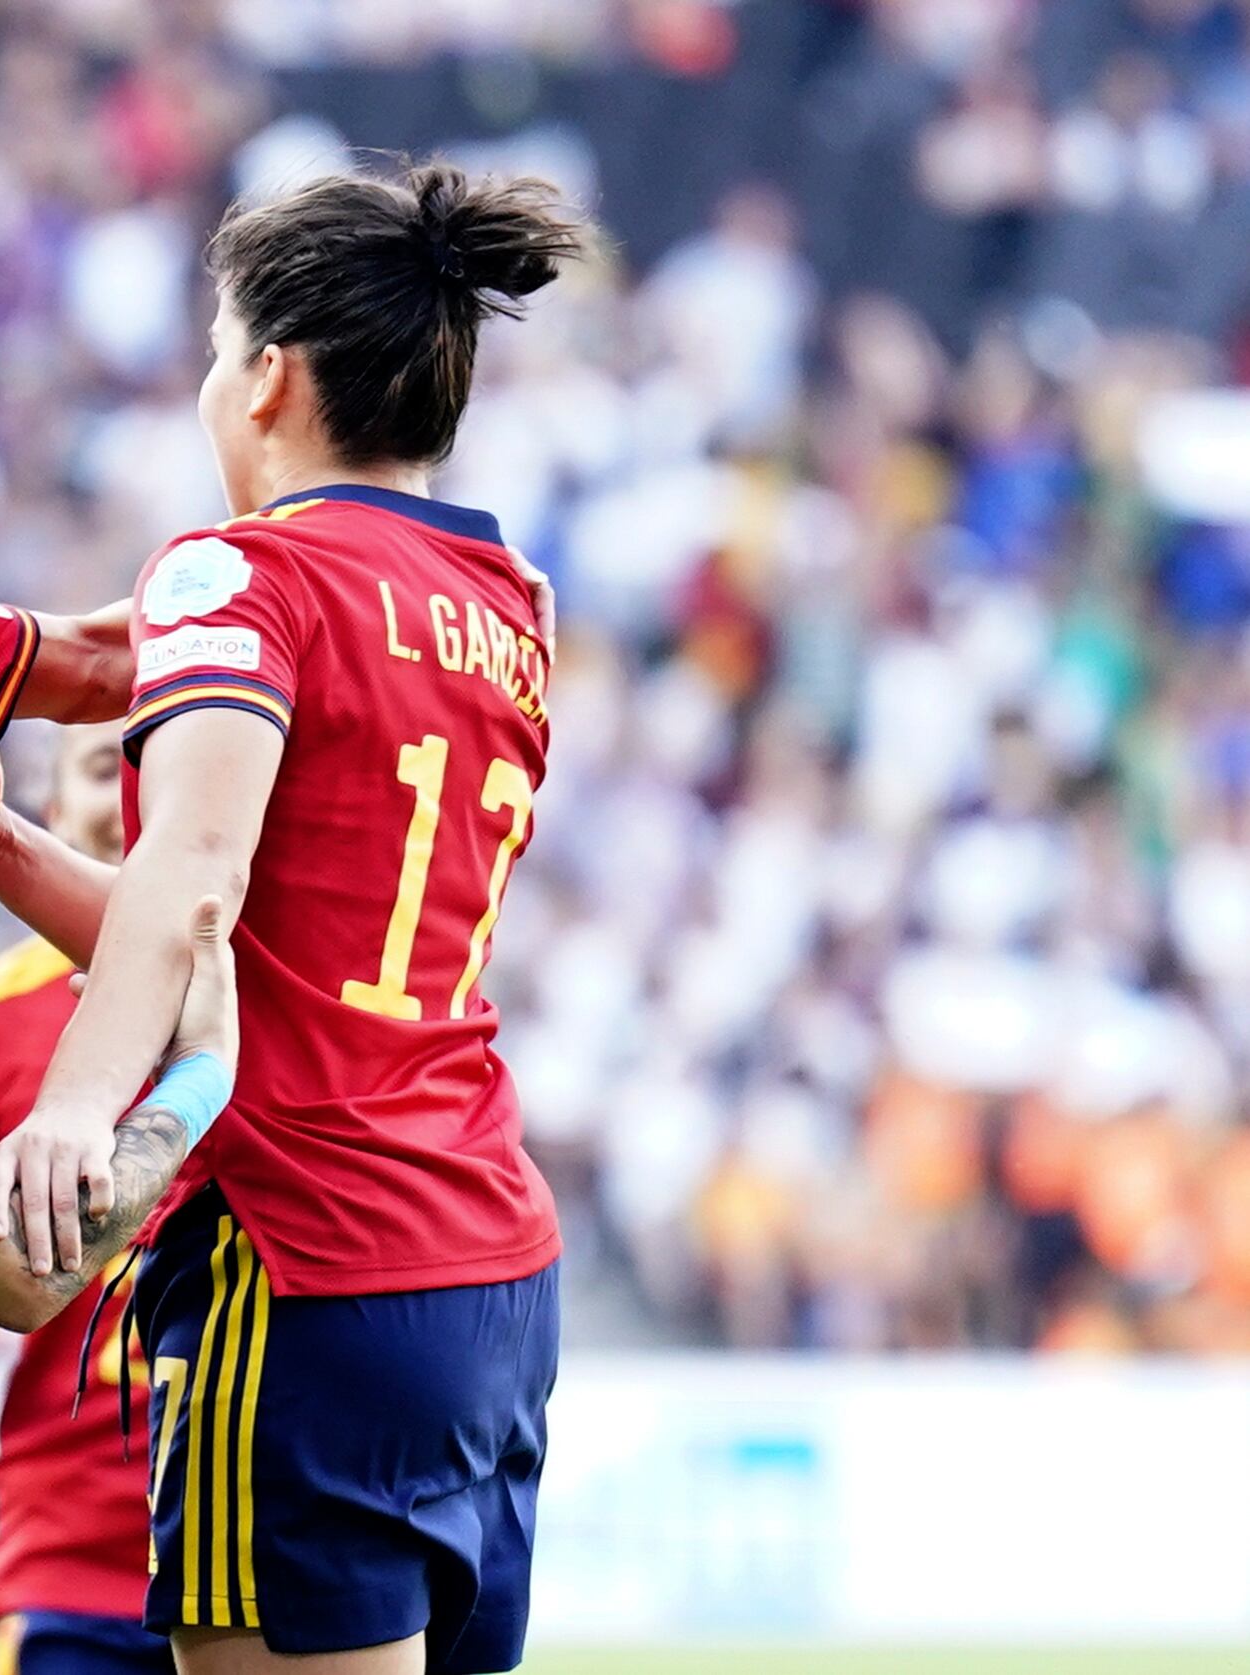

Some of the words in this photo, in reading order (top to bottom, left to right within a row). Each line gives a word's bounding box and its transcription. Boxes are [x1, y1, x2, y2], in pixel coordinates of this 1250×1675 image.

[141, 639, 255, 663] UNDATION
[378, 580, 422, 663] L.
[340, 733, 533, 1021] 17
